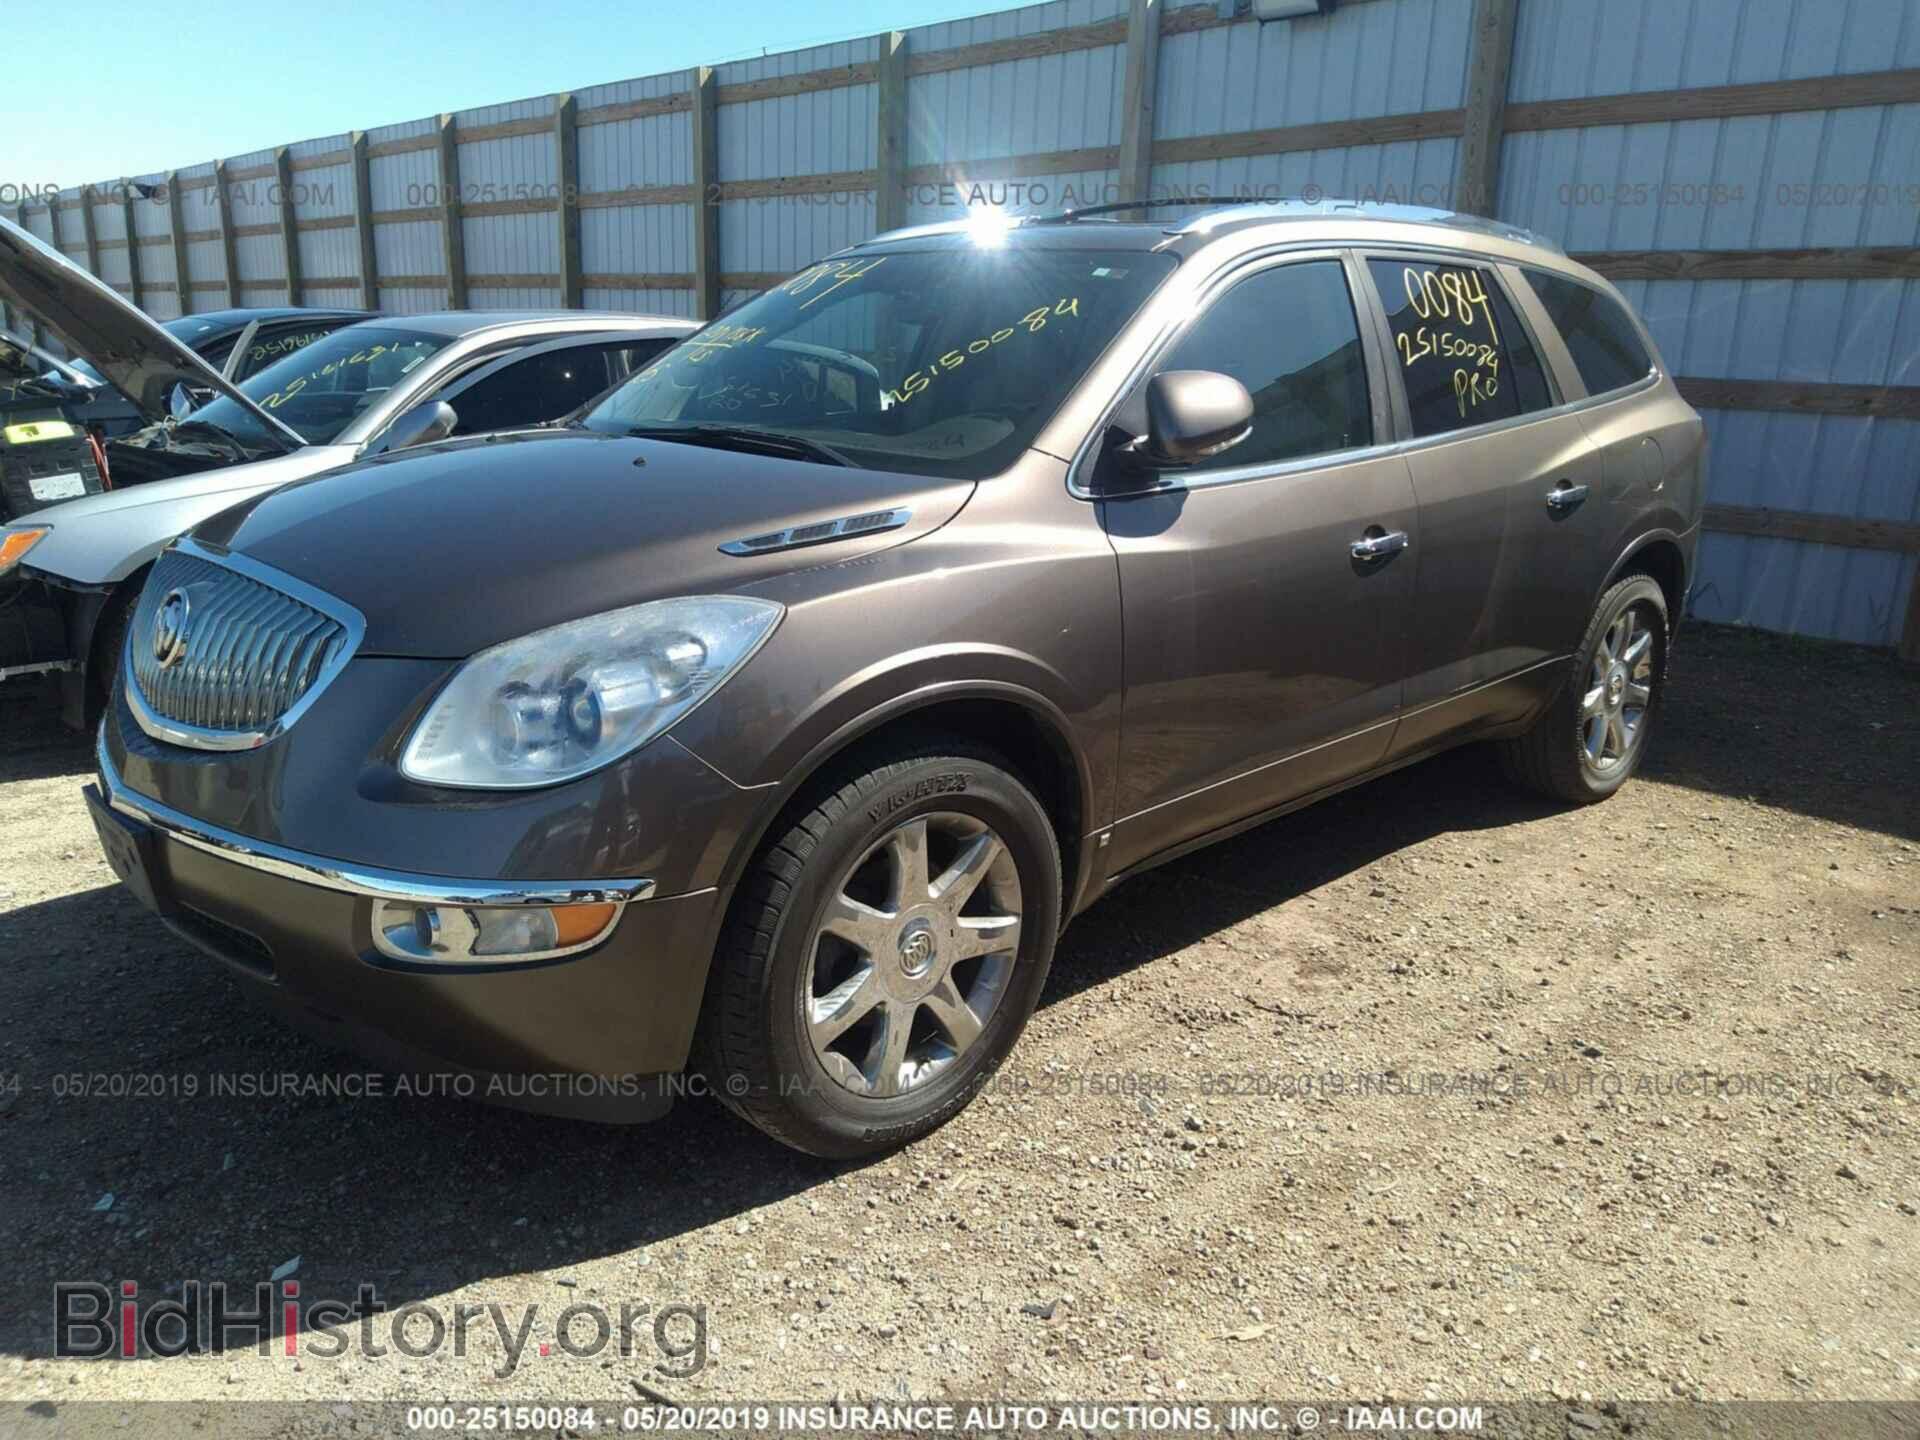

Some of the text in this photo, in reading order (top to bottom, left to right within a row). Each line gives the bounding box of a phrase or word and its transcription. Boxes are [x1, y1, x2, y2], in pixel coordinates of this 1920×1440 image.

[1403, 266, 1499, 346] 0084
[889, 297, 1080, 403] 25150084
[1397, 326, 1499, 378] 25150084
